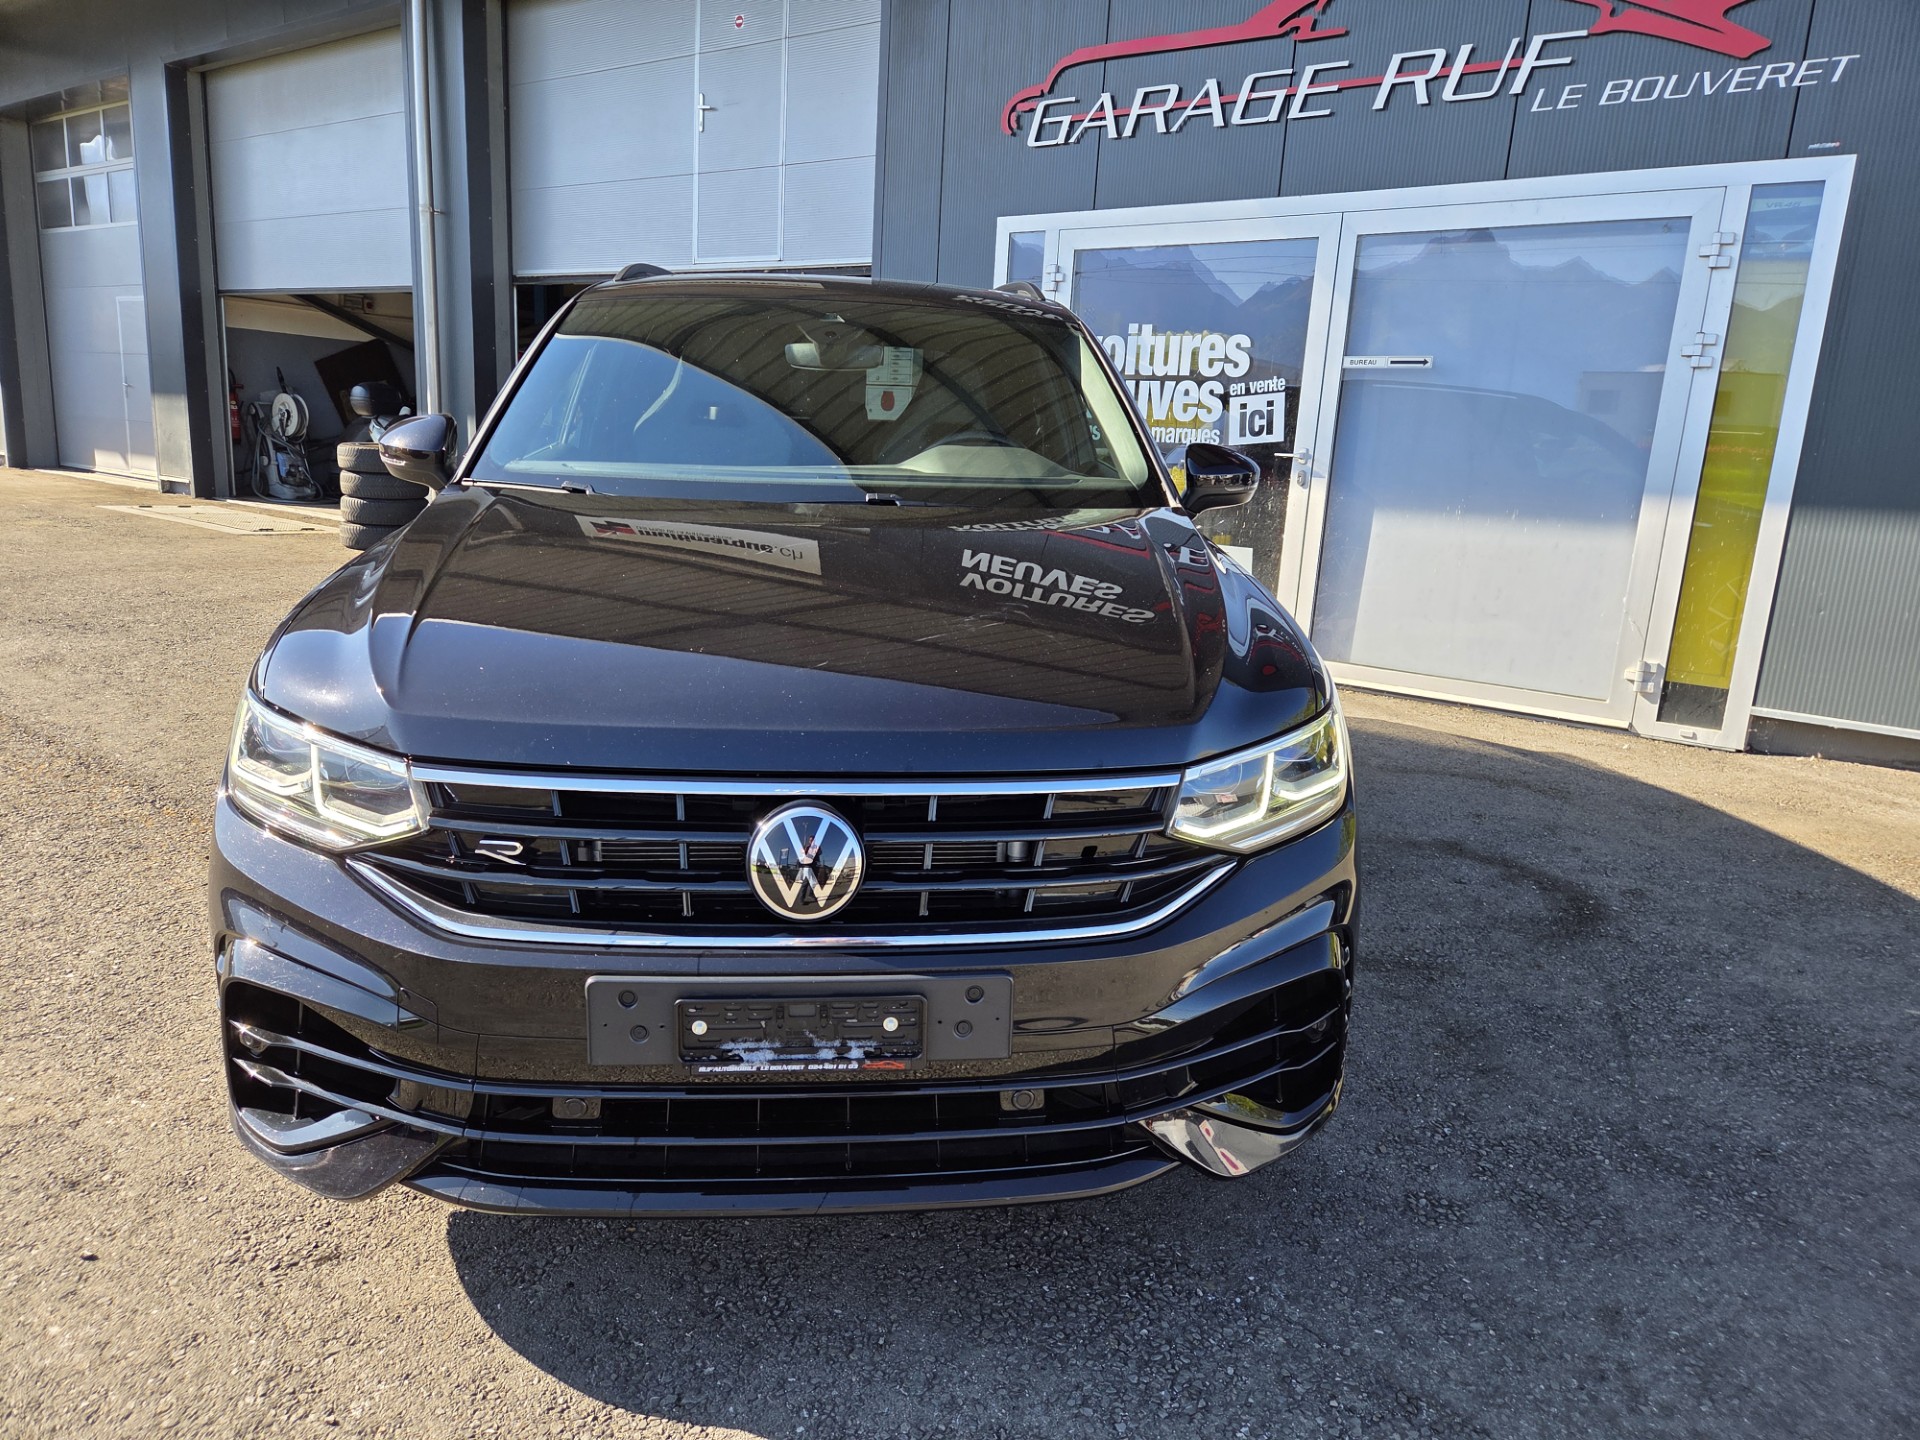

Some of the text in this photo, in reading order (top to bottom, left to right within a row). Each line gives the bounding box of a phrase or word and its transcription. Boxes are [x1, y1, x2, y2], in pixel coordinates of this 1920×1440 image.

[1027, 29, 1588, 147] GARAGE RUF
[1530, 54, 1861, 112] LE BOUVERET
[1099, 323, 1252, 377] oitures
[1125, 380, 1224, 422] uves
[1230, 376, 1286, 396] en vente
[1151, 426, 1220, 445] marques
[1239, 400, 1275, 438] ici
